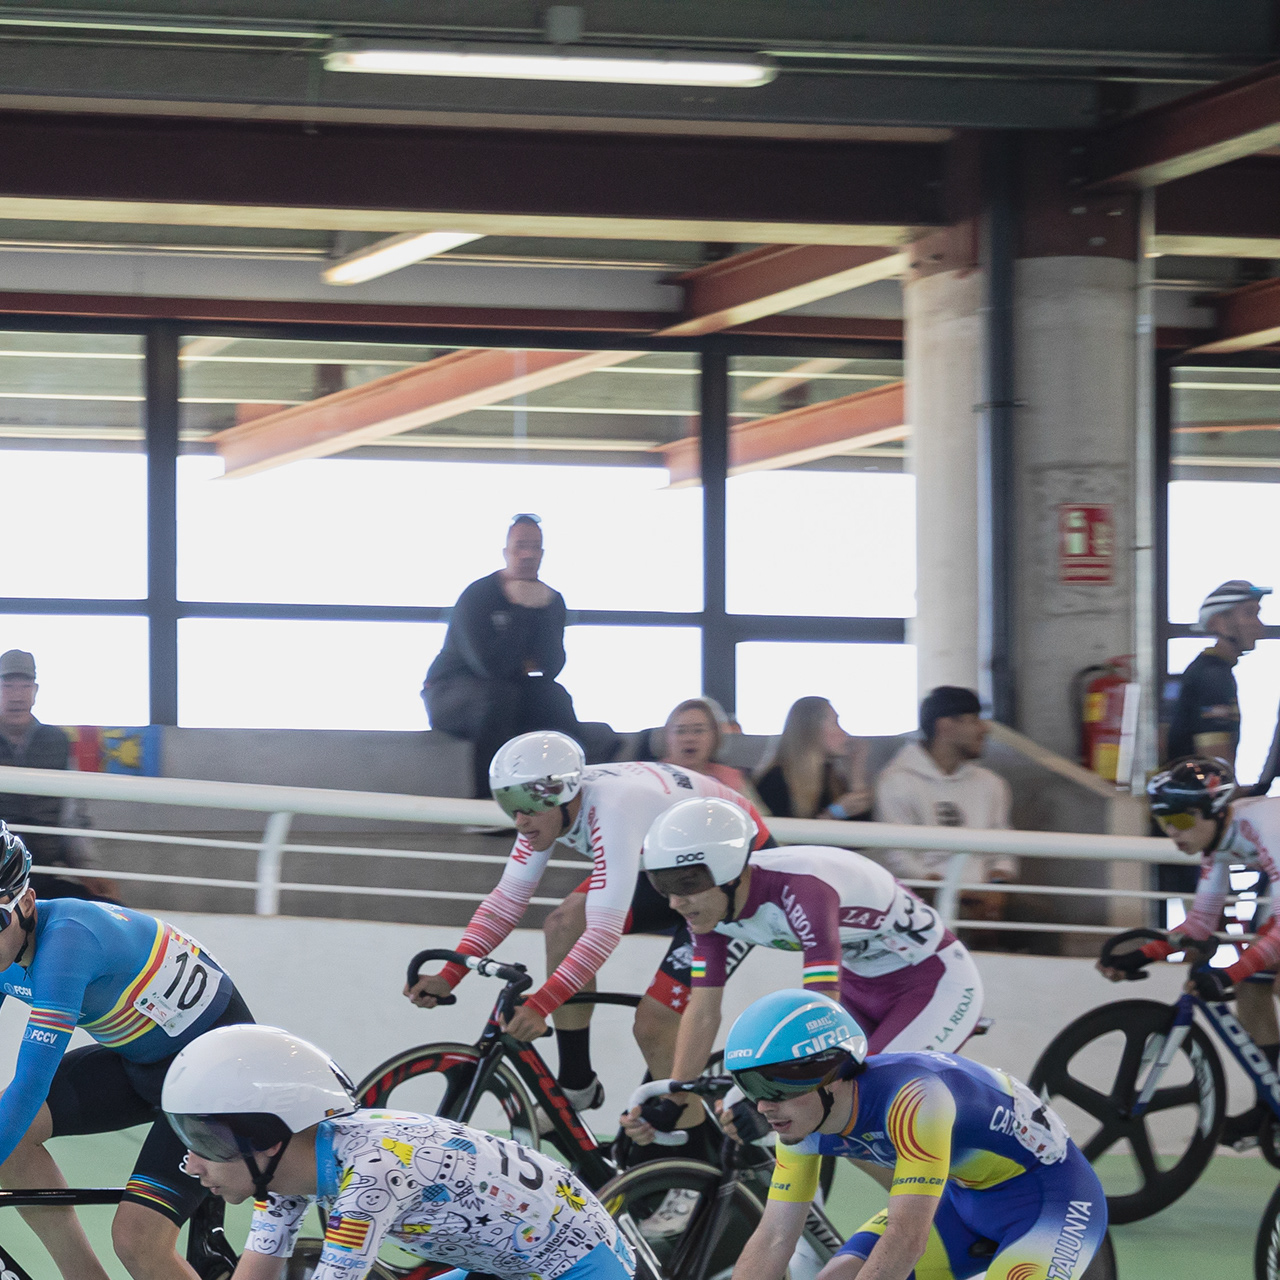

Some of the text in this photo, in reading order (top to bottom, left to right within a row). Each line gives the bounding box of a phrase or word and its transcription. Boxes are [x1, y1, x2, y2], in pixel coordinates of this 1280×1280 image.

[780, 885, 818, 951] LA RIOJA
[14, 985, 33, 997] FCCV
[162, 951, 209, 1011] 10
[934, 986, 975, 1045] LA RIOJA
[30, 1029, 58, 1045] FCCV
[727, 1048, 753, 1060] GIRO
[791, 1025, 850, 1059] GIRO
